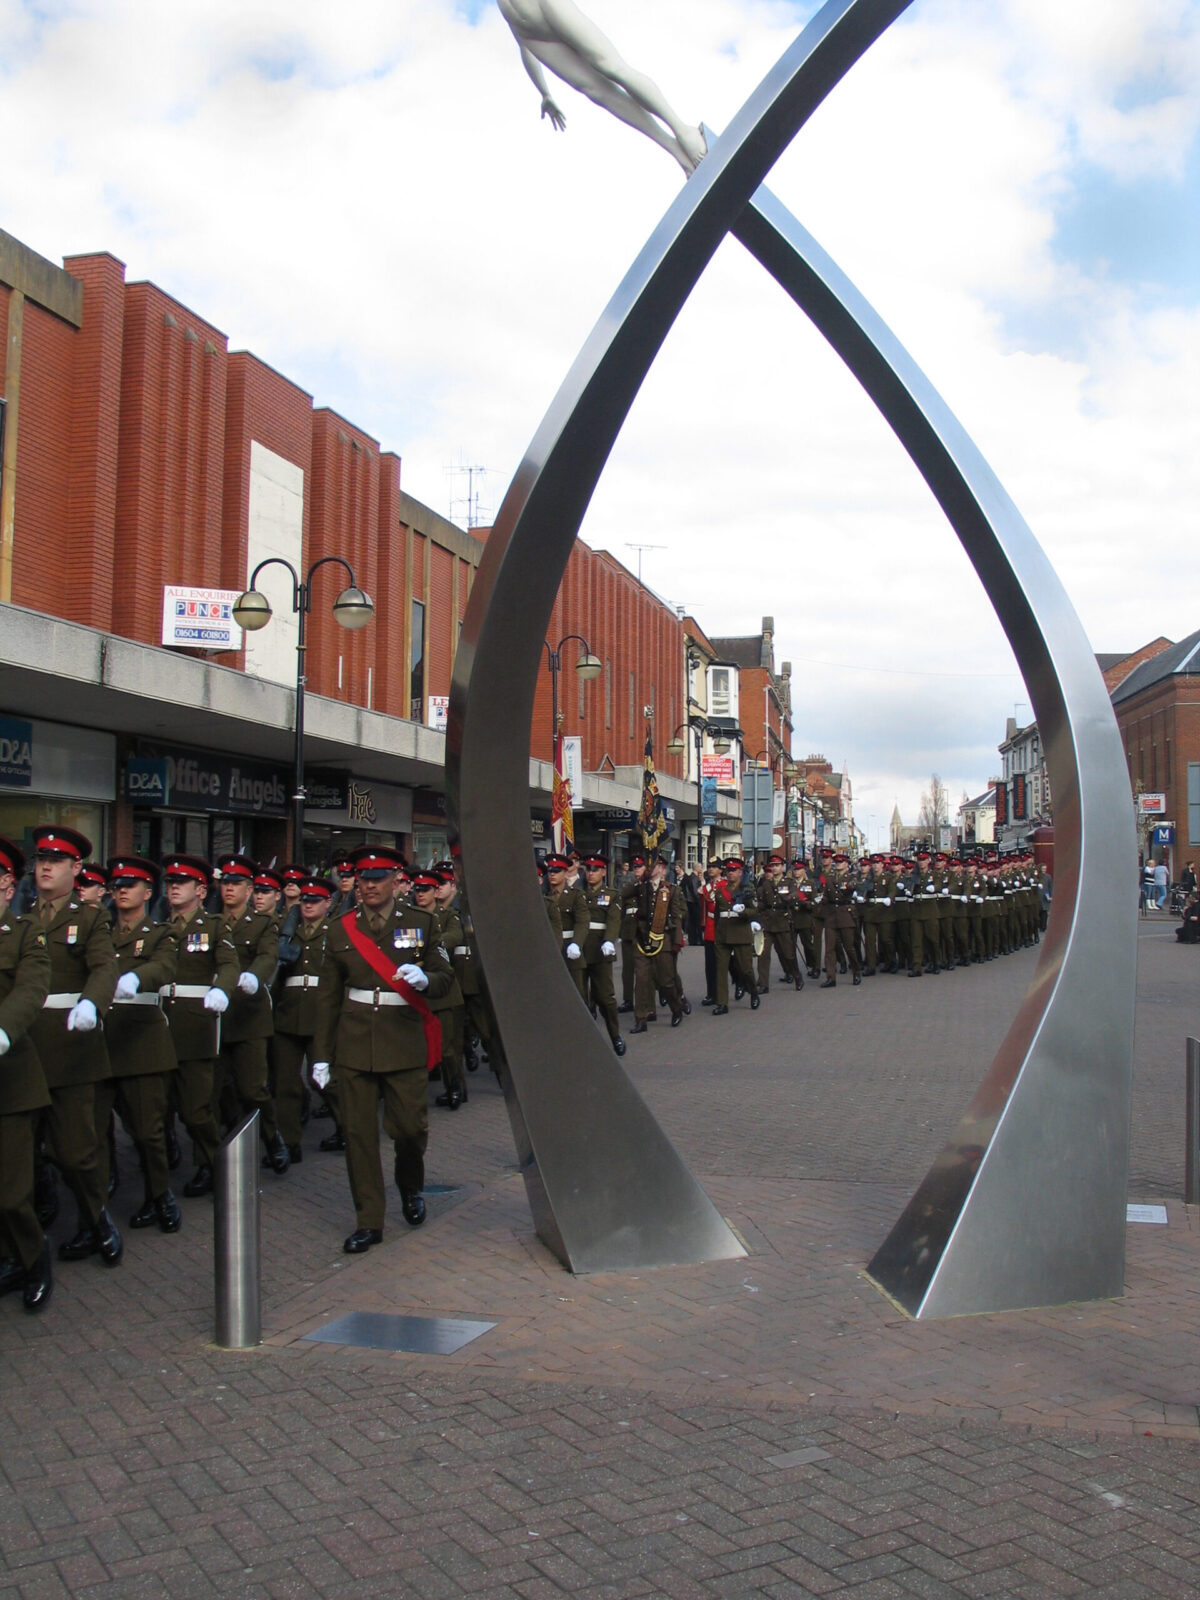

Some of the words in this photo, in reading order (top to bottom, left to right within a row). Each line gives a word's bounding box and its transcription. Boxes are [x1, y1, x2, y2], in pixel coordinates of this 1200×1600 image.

[167, 588, 185, 597] ALL
[190, 590, 240, 600] ENQUIRIES
[176, 601, 230, 618] PUNCH
[175, 628, 198, 638] 01604
[201, 630, 229, 640] 601800
[0, 738, 32, 766] D&A
[129, 773, 163, 789] D&A
[165, 756, 221, 796] Office
[229, 767, 286, 810] Angels
